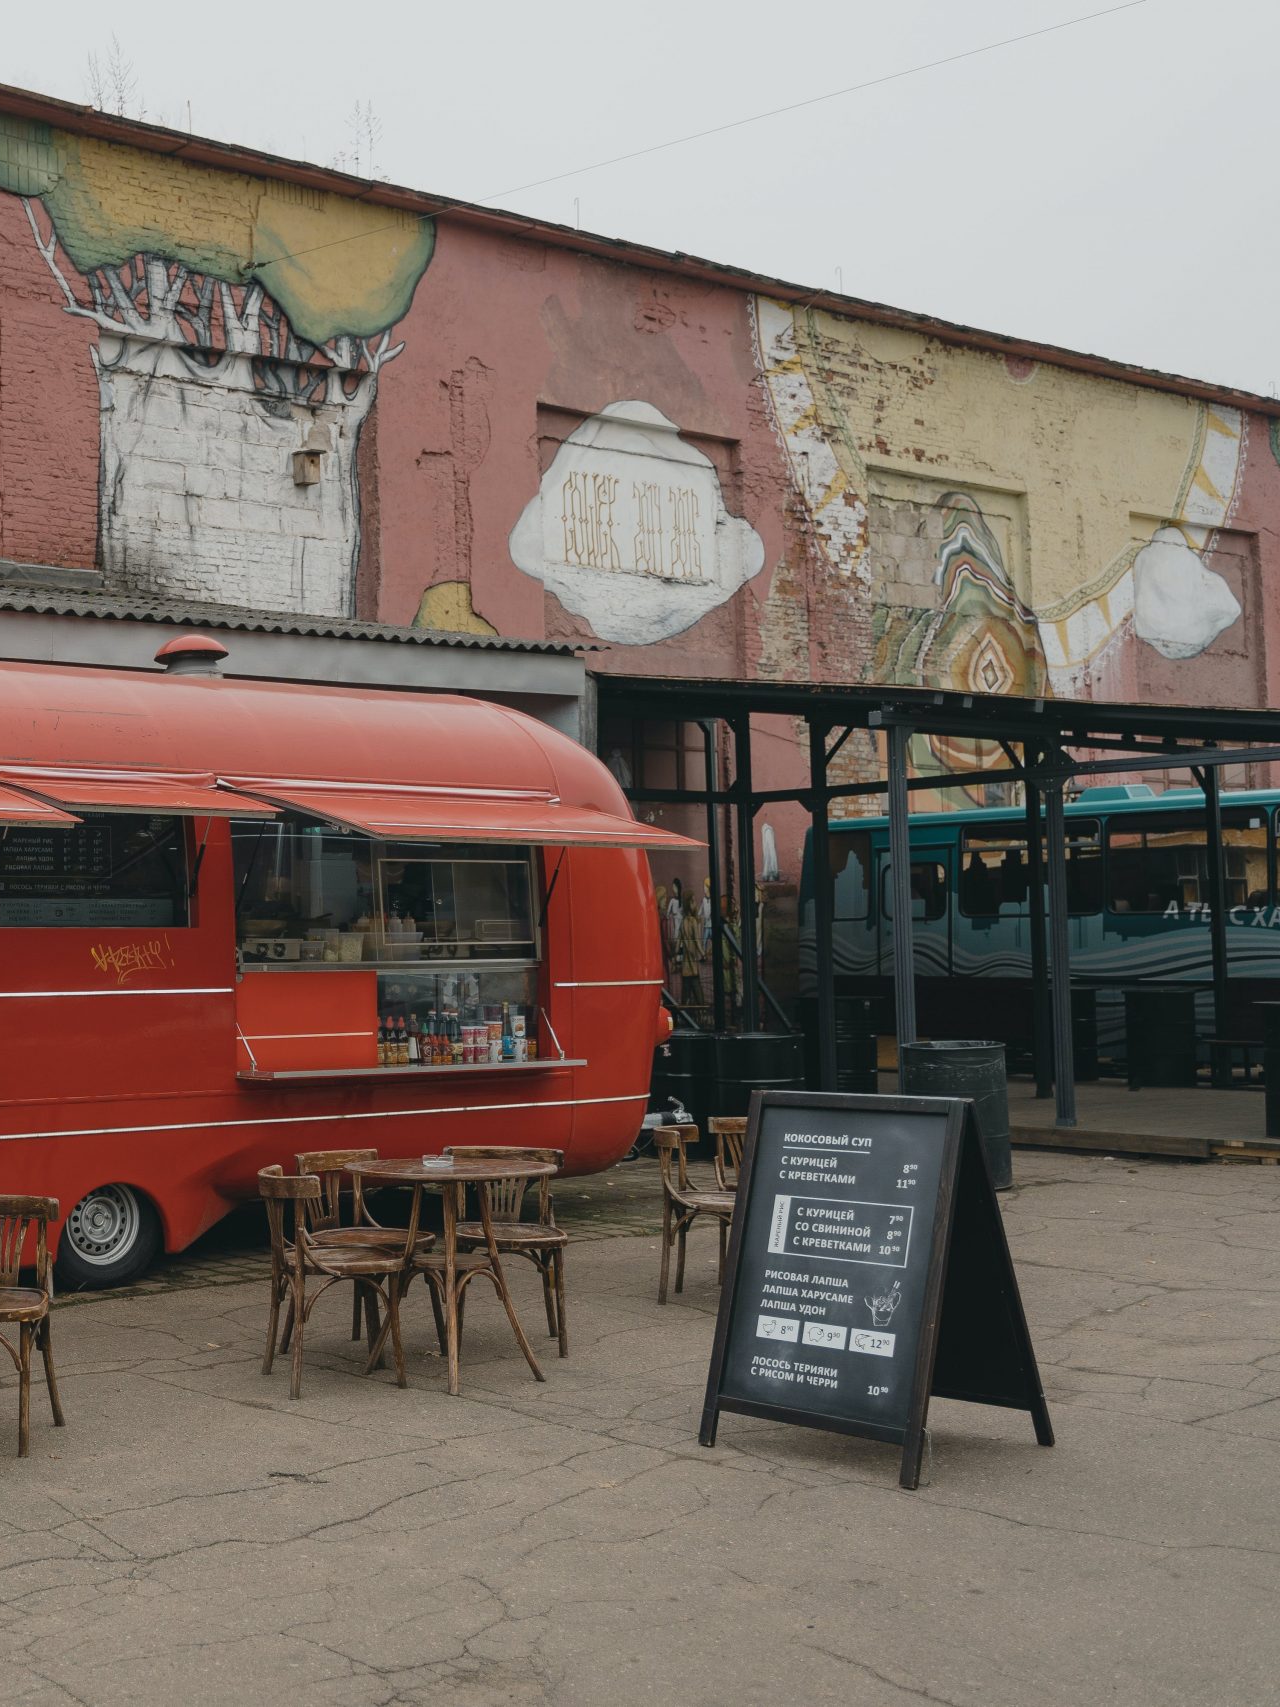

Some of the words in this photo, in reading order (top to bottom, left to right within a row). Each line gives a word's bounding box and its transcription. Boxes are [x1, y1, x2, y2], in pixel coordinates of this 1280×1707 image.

[784, 1133, 848, 1146] КОКОСОВЫЙ
[851, 1137, 872, 1147] СУП
[781, 1155, 788, 1164] С
[790, 1156, 838, 1169] КУРИЦЕЙ
[779, 1170, 786, 1179] С
[788, 1171, 856, 1184] КРЕВЕТКАМИ
[797, 1207, 804, 1216] С
[806, 1208, 855, 1221] КУРИЦЕЙ
[795, 1222, 809, 1231] СО
[812, 1223, 871, 1238] СВИНИНОЙ
[793, 1236, 800, 1246] С
[802, 1237, 871, 1253] КРЕВЕТКАМИ
[765, 1269, 809, 1283] РИСОВАЯ
[811, 1275, 849, 1288] ЛАПША
[762, 1284, 798, 1297] ЛАПША
[800, 1289, 853, 1304] ХАРУСАМЕ
[760, 1299, 796, 1312] ЛАПША
[799, 1304, 826, 1316] УДОН
[752, 1355, 791, 1370] ЛОСОСЬ
[794, 1362, 838, 1378] ТЕРИЯКИ
[750, 1366, 757, 1375] С
[759, 1367, 794, 1382] РИСОМ
[797, 1374, 804, 1383] И
[807, 1375, 838, 1389] ЧЕРРИ
